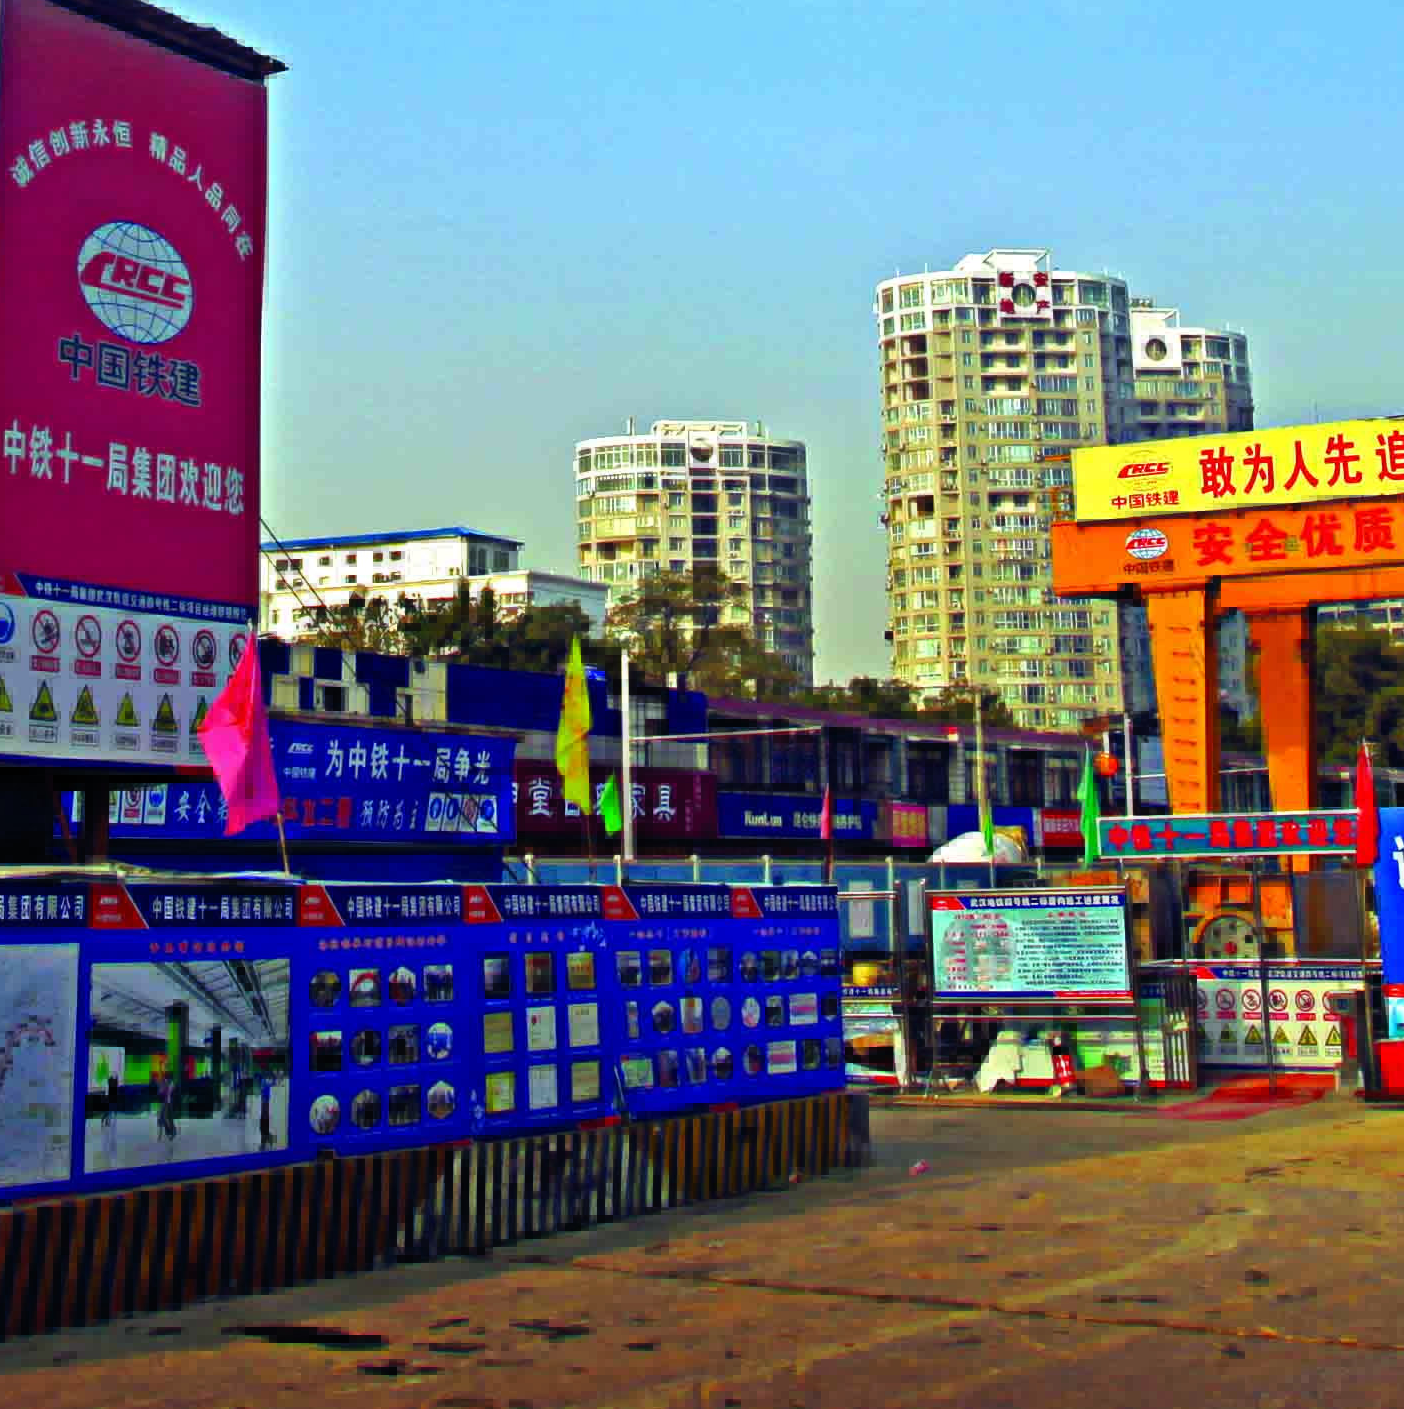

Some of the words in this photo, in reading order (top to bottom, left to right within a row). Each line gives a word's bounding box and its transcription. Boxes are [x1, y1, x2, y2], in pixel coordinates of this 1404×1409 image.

[9, 119, 134, 189] 诚信创新永恒
[78, 251, 191, 309] CRCC
[58, 334, 202, 408] 中国铁建
[3, 418, 246, 515] 中铁十一局集团欢迎您
[1117, 462, 1172, 479] CRCC
[1110, 489, 1181, 510] 中国铁建
[325, 739, 492, 786] 为中铁十一局争光
[152, 894, 294, 921] 中国铁建十一局集团有限公司
